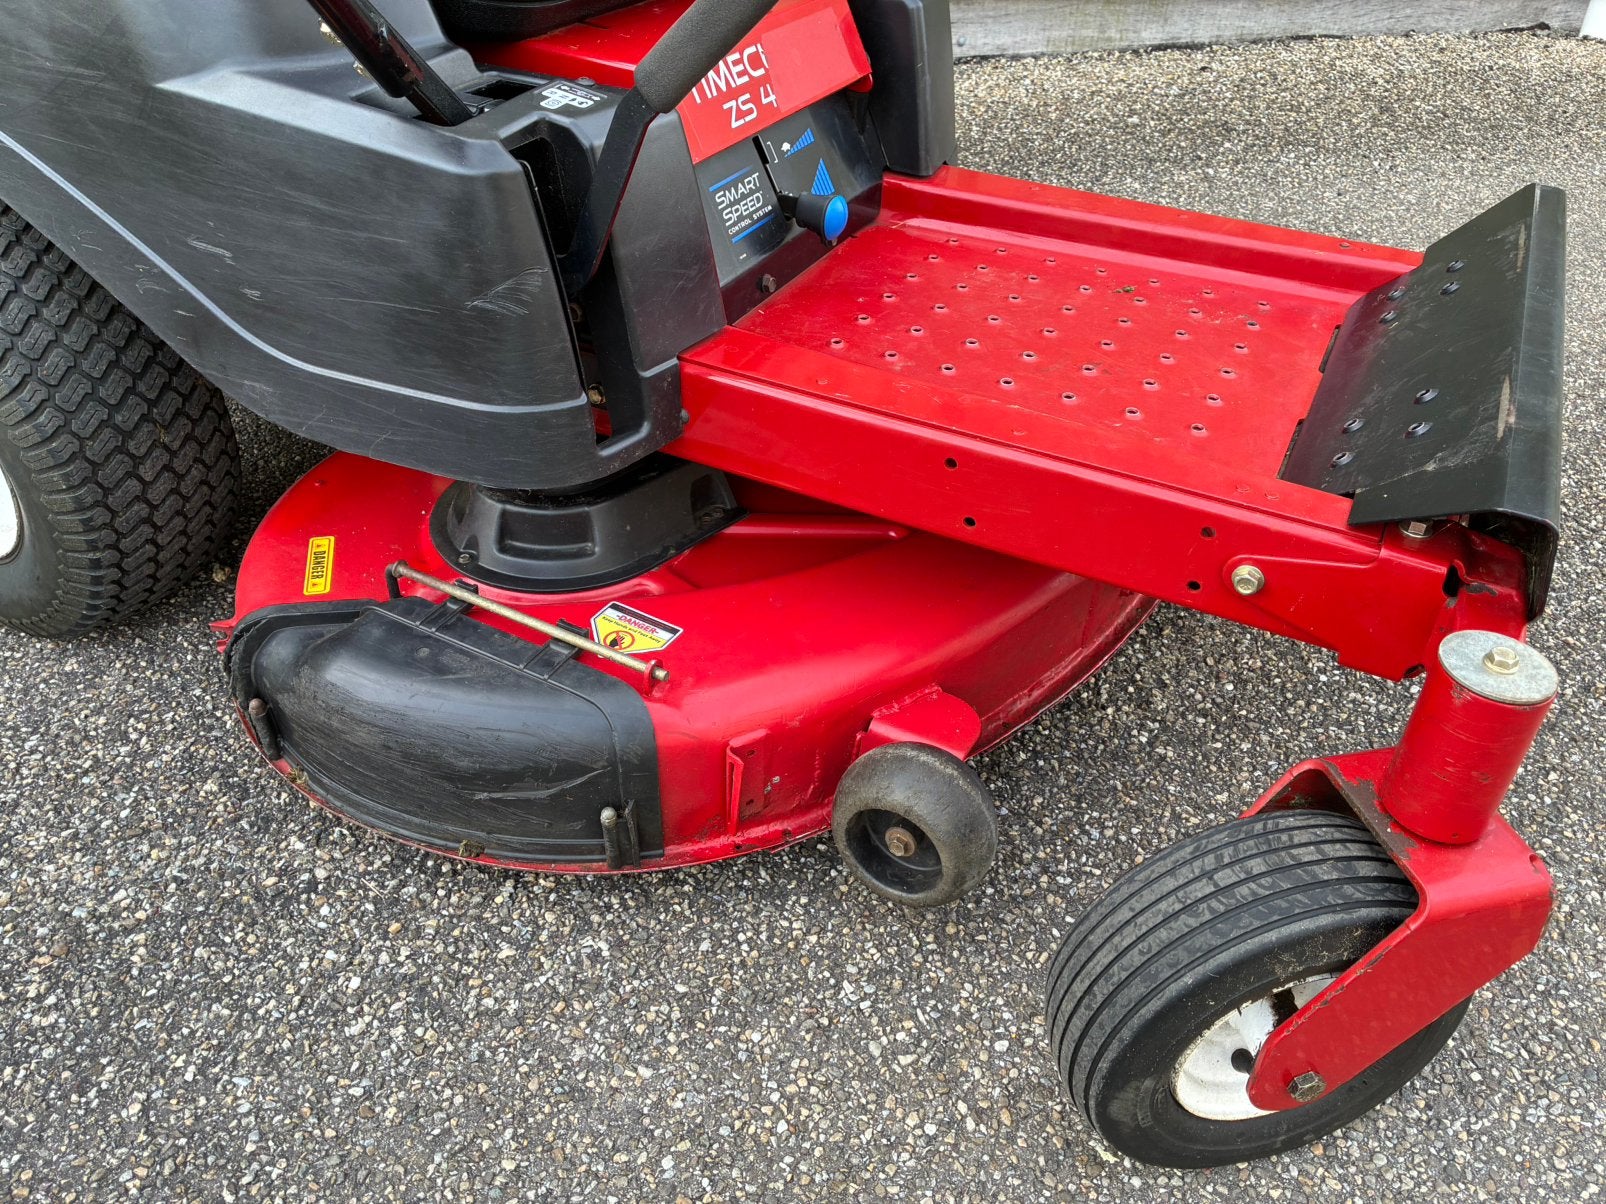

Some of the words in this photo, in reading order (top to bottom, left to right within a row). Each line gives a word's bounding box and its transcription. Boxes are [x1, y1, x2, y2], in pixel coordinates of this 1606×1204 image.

[722, 93, 758, 129] ZS
[715, 172, 760, 210] SMART
[722, 191, 763, 226] SPEED
[728, 218, 752, 235] CONTROL
[752, 204, 773, 220] SYSTEM
[310, 550, 327, 580] DANGER
